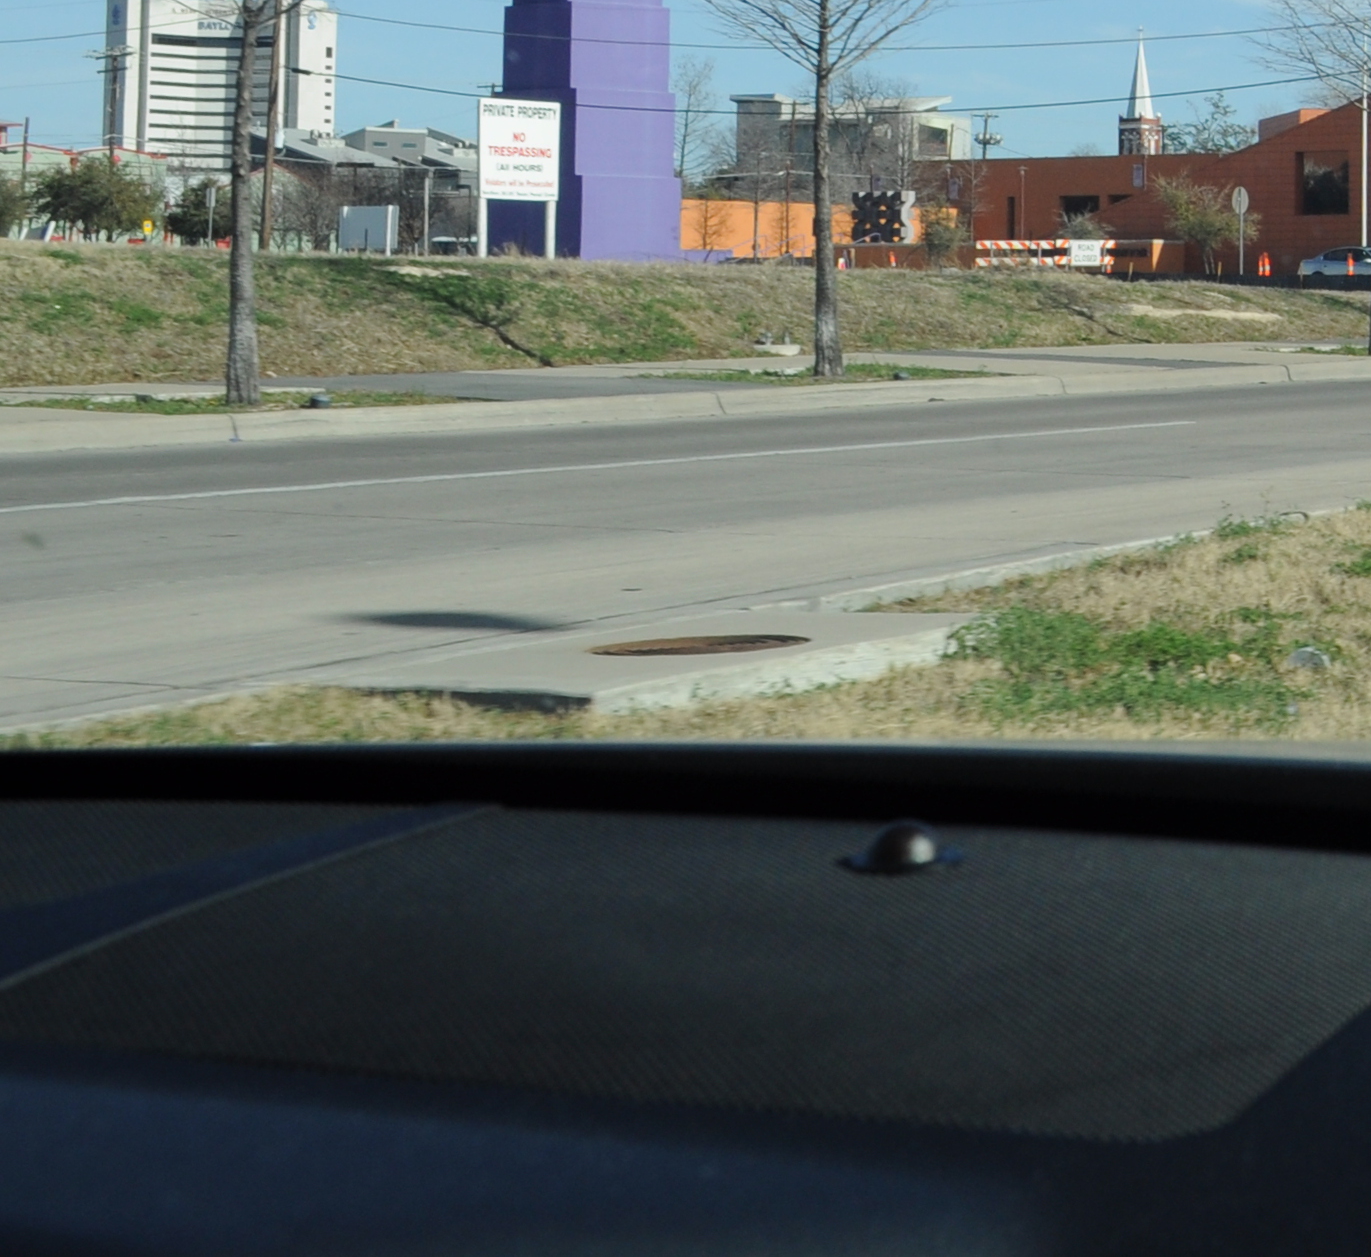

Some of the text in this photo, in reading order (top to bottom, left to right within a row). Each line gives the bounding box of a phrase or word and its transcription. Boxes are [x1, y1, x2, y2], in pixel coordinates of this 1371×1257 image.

[483, 104, 557, 120] PRIVATE PROPERTY
[513, 132, 526, 143] NO
[488, 145, 552, 159] TRESPASSING
[1074, 254, 1098, 262] CLOSED
